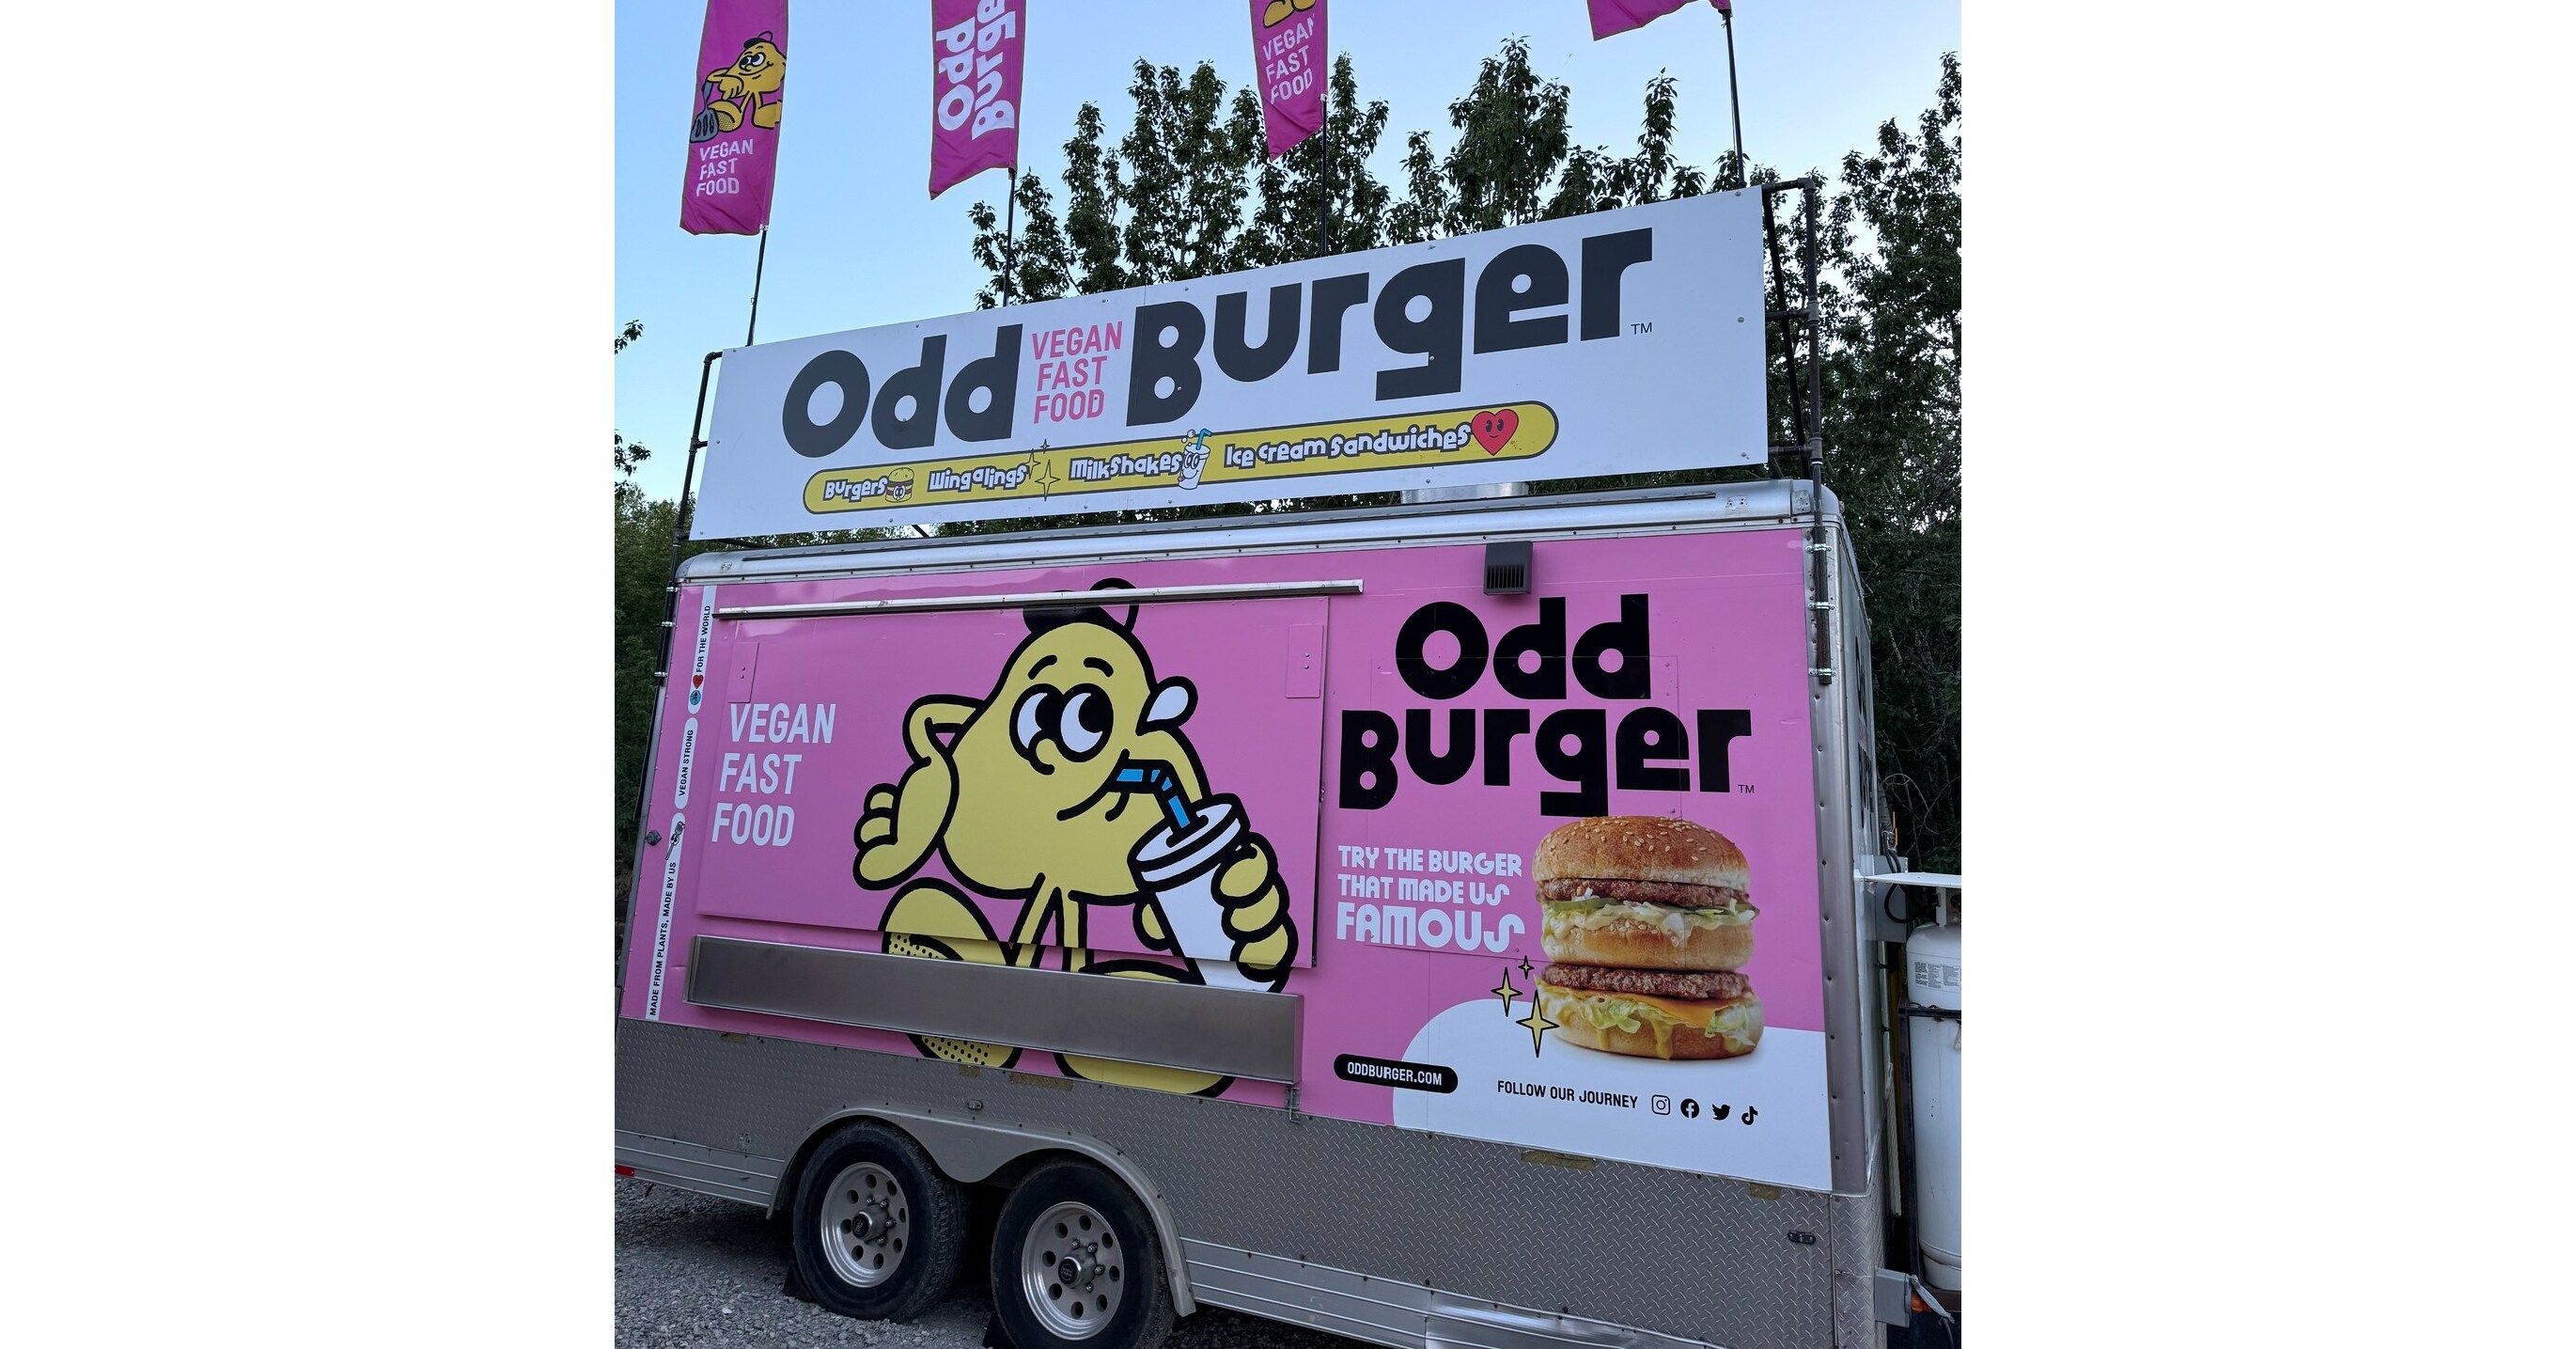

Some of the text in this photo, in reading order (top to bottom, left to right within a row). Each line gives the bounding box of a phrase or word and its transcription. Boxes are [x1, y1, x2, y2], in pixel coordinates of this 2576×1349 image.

[936, 16, 976, 131] Odd
[1265, 44, 1309, 85] FAST
[1270, 68, 1313, 105] FOOD
[699, 138, 754, 162] VEGAN
[699, 158, 738, 180] FAST
[695, 178, 740, 197] FOOD
[782, 227, 1653, 458] Odd Burger TM
[1032, 321, 1123, 360] VEGAN
[1037, 355, 1107, 391] FAST
[1034, 389, 1104, 424] FOOD
[822, 475, 888, 502] Burgers
[927, 464, 1029, 493] Wingalings
[1224, 443, 1256, 469] Ice
[695, 656, 704, 673] FOR
[701, 605, 710, 635] WORLD
[1396, 593, 1651, 699] Odd
[730, 703, 836, 744] VEGAN
[679, 729, 694, 796] VEGAN STRONG
[719, 753, 803, 794] FAST
[1339, 706, 1755, 817] Burger TM
[711, 803, 795, 846] FOOD
[668, 862, 676, 874] US
[1338, 845, 1522, 878] TRY THE BURGER
[666, 877, 674, 888] BY
[1338, 873, 1510, 906] THAT MADE US
[663, 891, 672, 917] MADE
[1336, 902, 1525, 953] FAMOUS
[653, 961, 663, 986] FROM
[649, 989, 659, 1016] MADE
[1348, 1061, 1443, 1086] ODDBURGER.COM
[1497, 1080, 1638, 1108] FOLLOW OUR JOURNEY
